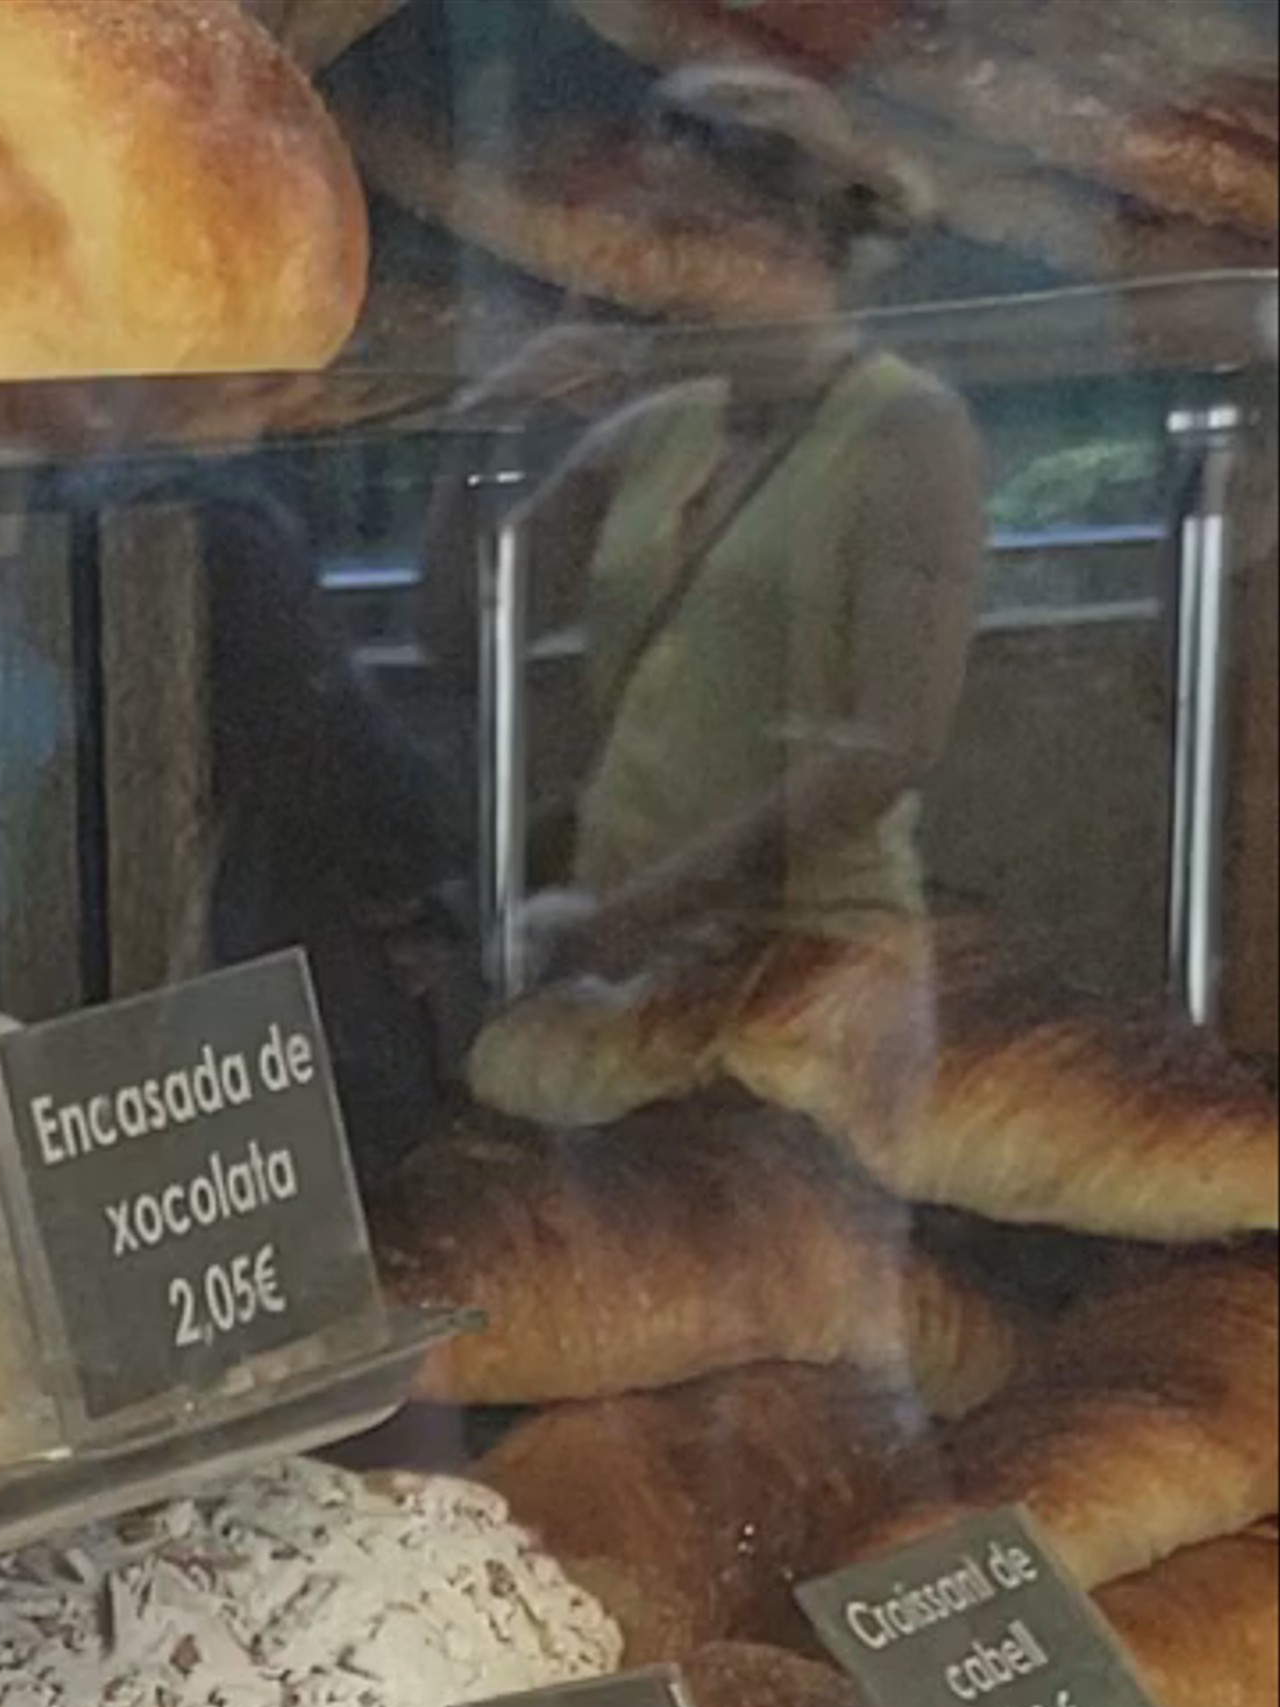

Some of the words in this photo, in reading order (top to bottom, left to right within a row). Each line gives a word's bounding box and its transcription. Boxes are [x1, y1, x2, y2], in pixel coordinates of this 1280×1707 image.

[30, 1044, 252, 1165] Encasada
[260, 1022, 314, 1092] de
[105, 1141, 298, 1257] xocolata
[168, 1244, 287, 1348] 2,05€
[847, 1554, 995, 1648] Croissant
[988, 1540, 1038, 1589] de
